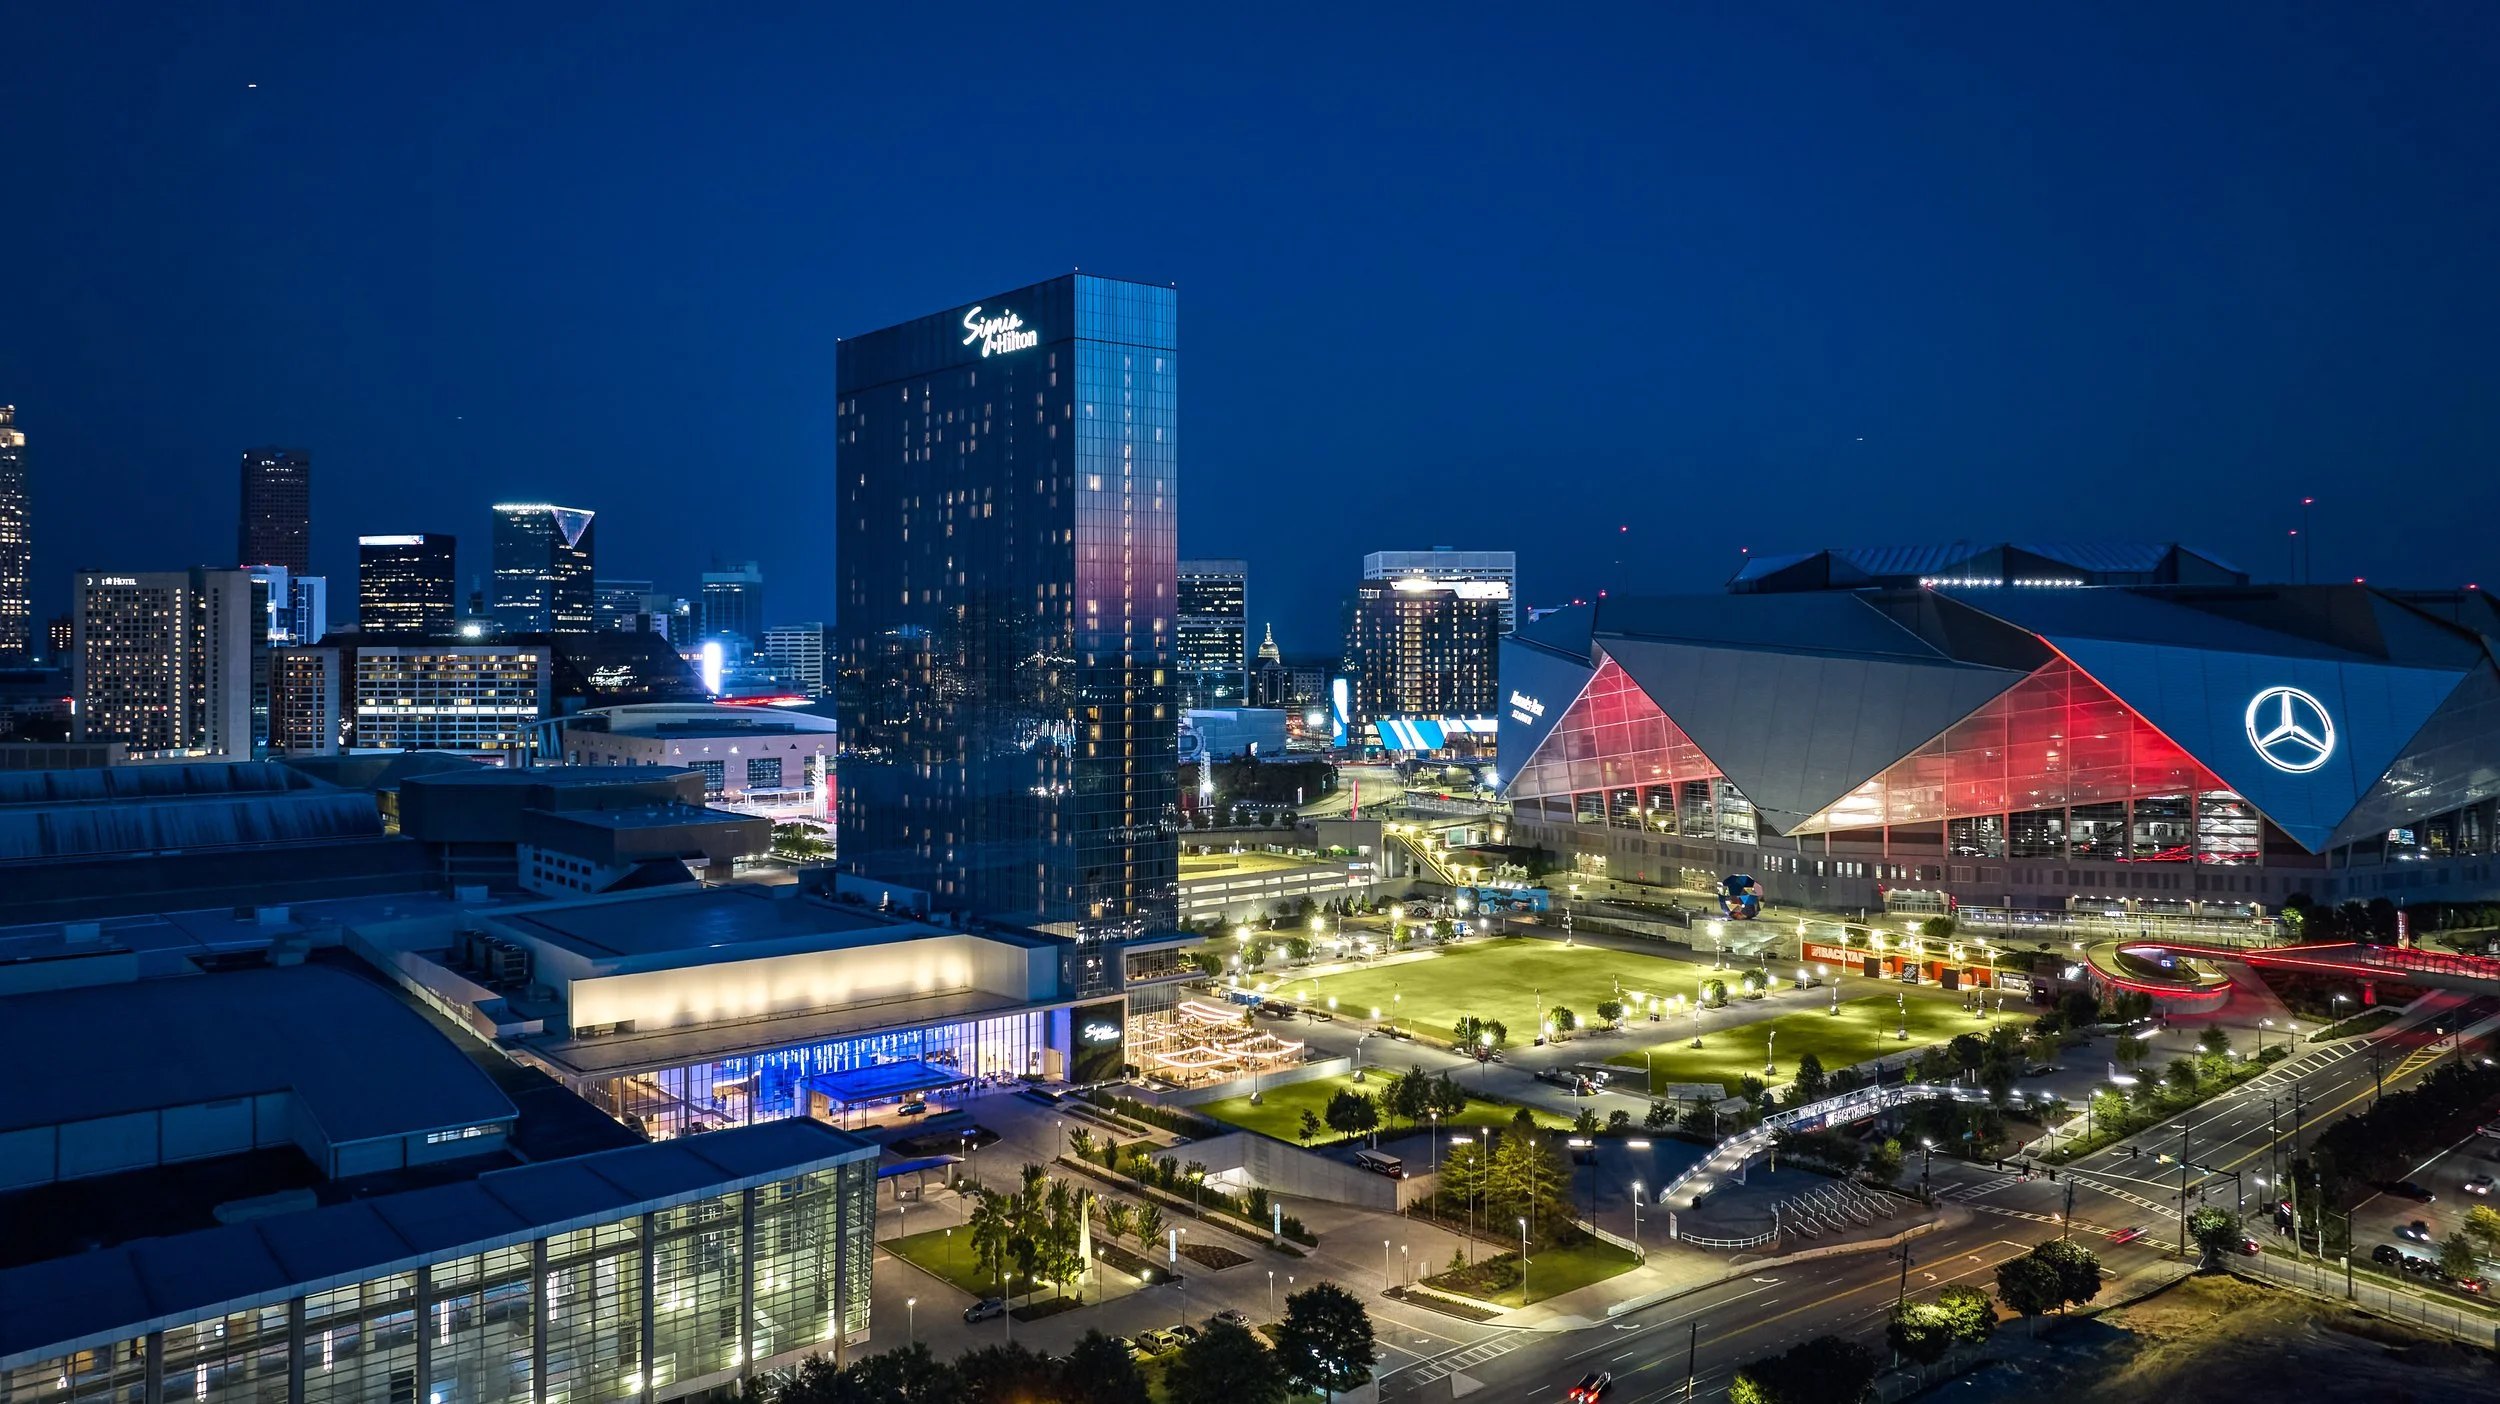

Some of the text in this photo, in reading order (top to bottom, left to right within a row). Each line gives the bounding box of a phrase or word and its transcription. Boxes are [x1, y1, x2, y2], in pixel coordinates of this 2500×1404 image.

[962, 305, 1023, 358] Signia
[996, 330, 1037, 354] Hilton
[1819, 946, 1865, 964] BACKYAR
